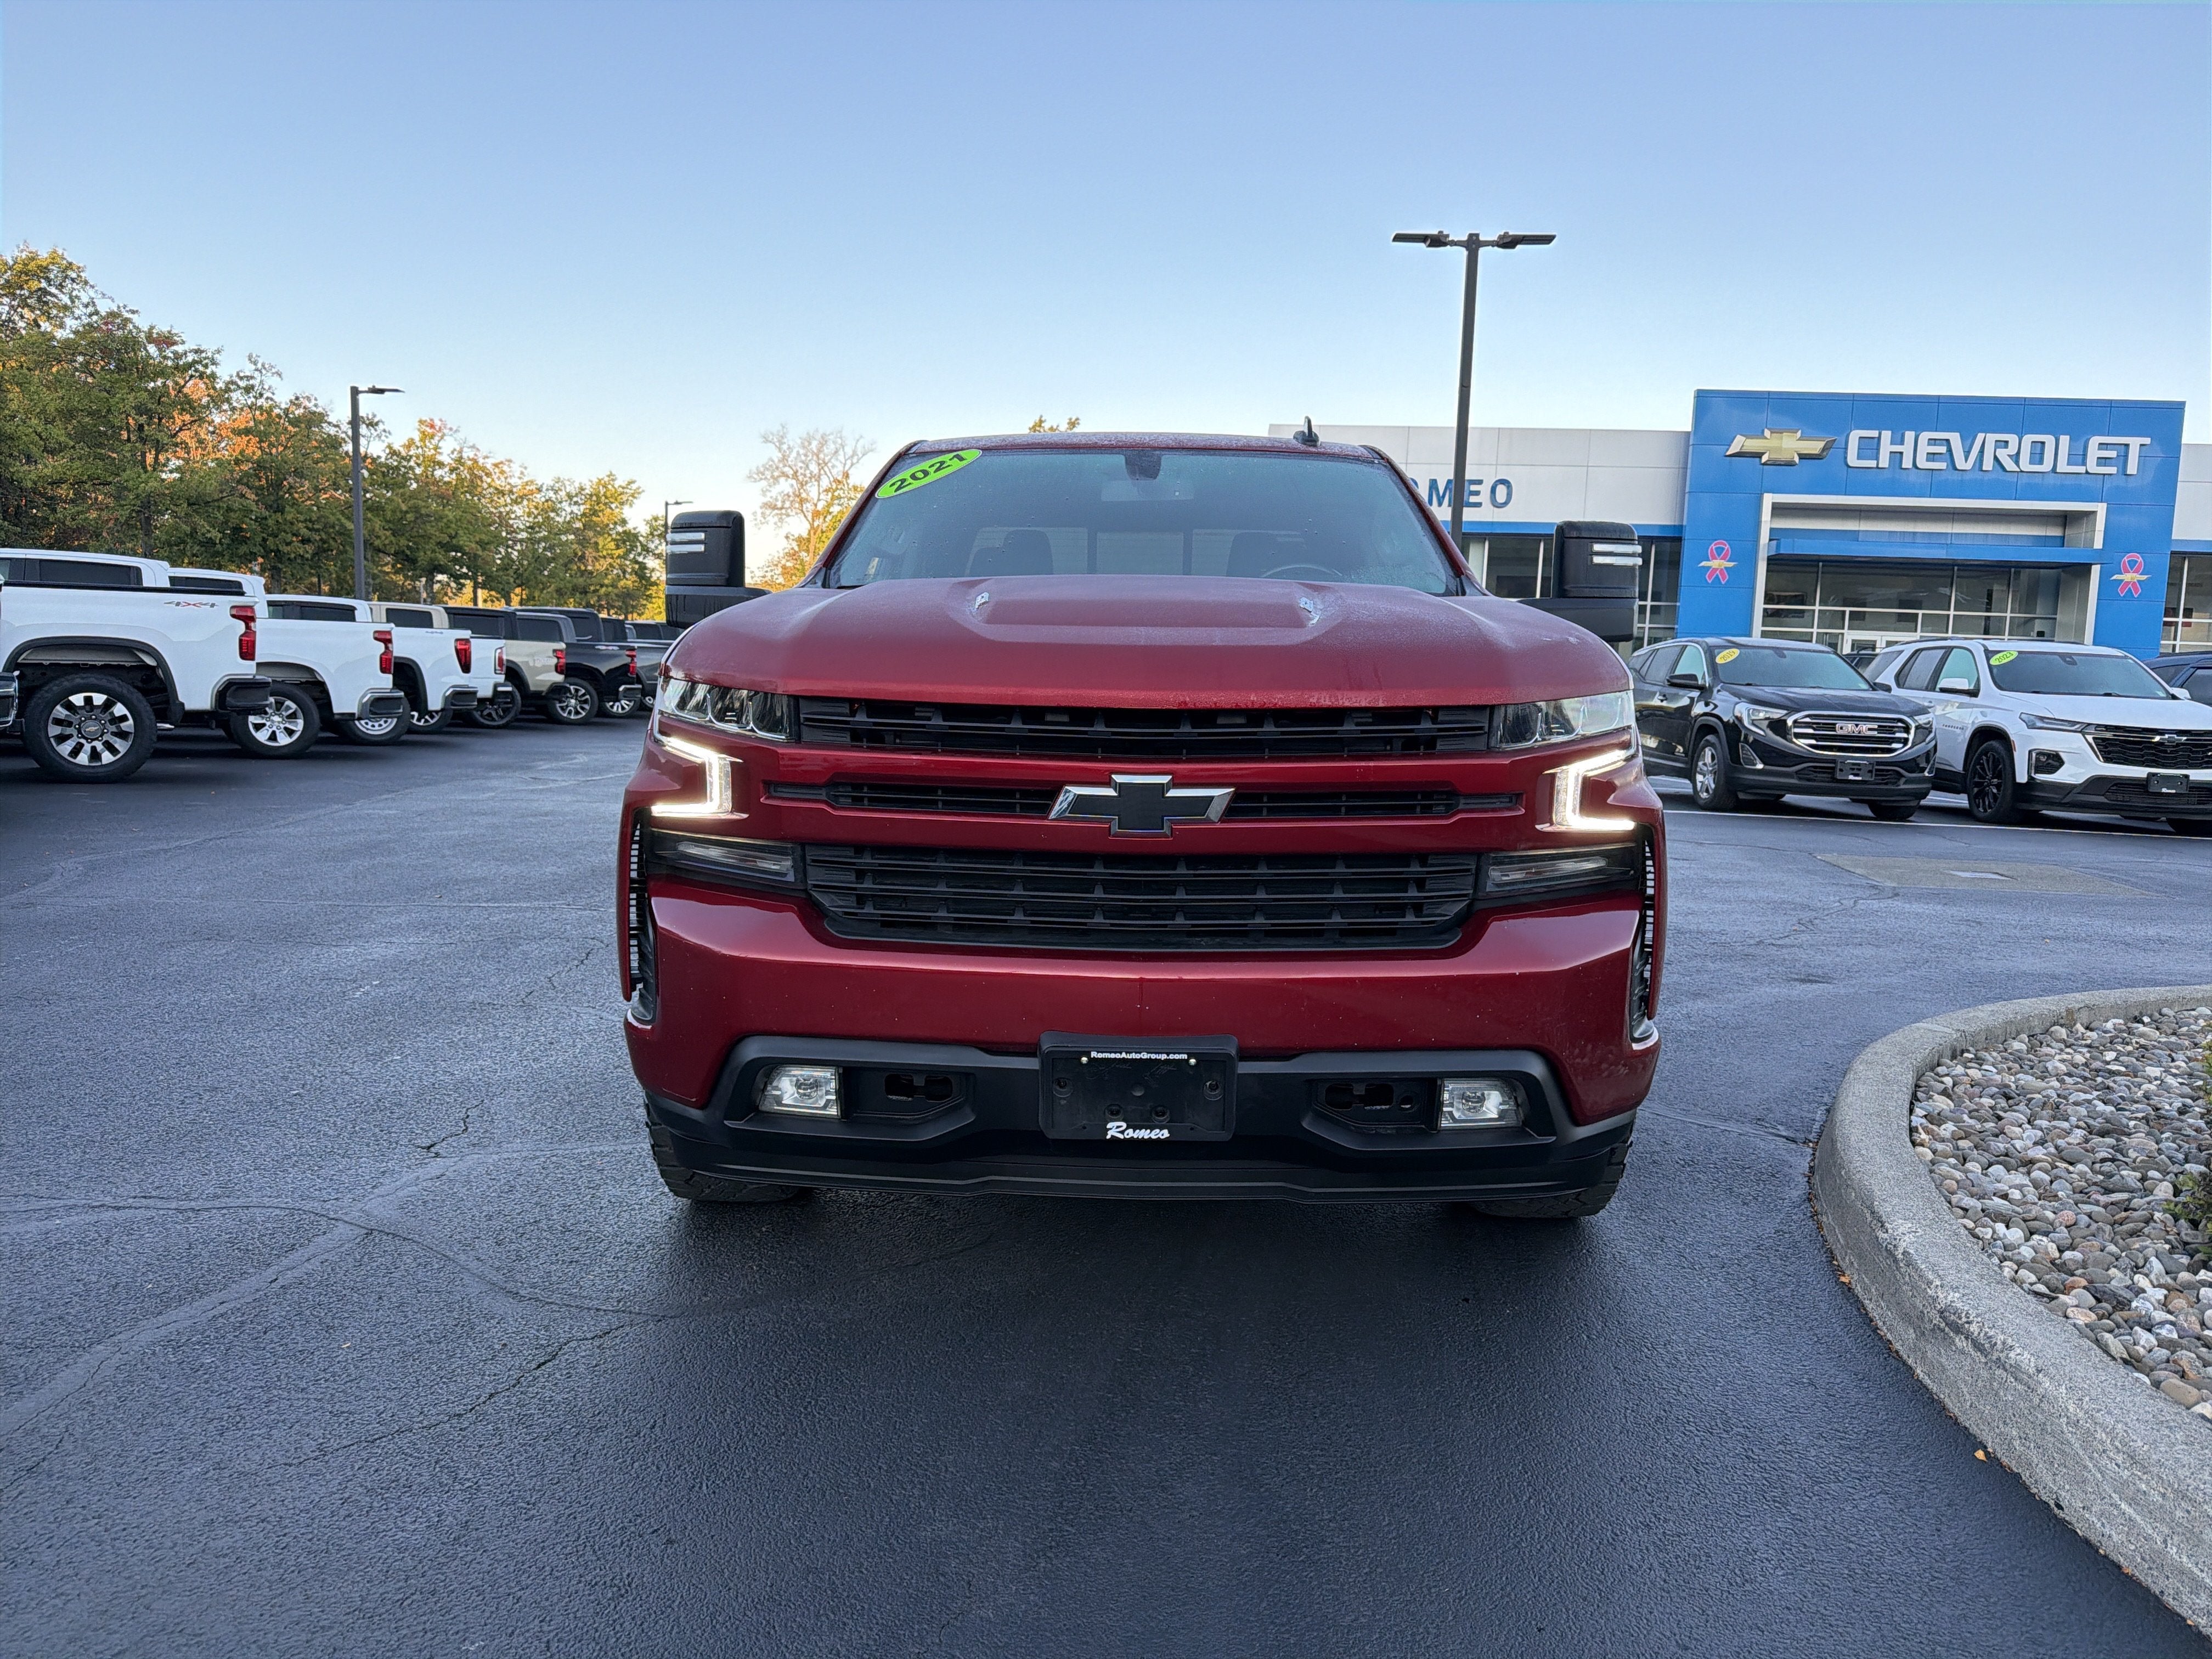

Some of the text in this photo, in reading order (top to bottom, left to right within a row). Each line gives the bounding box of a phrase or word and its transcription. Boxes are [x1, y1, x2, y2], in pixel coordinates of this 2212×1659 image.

[1847, 430, 2151, 475] CHEVROLET
[889, 453, 968, 493] 2021
[1409, 477, 1513, 508] MEO
[1995, 652, 2014, 663] 2023
[1836, 723, 1878, 735] GMC
[1091, 1051, 1188, 1060] RomeoAutoGroup.com
[1106, 1121, 1170, 1139] Romeo
